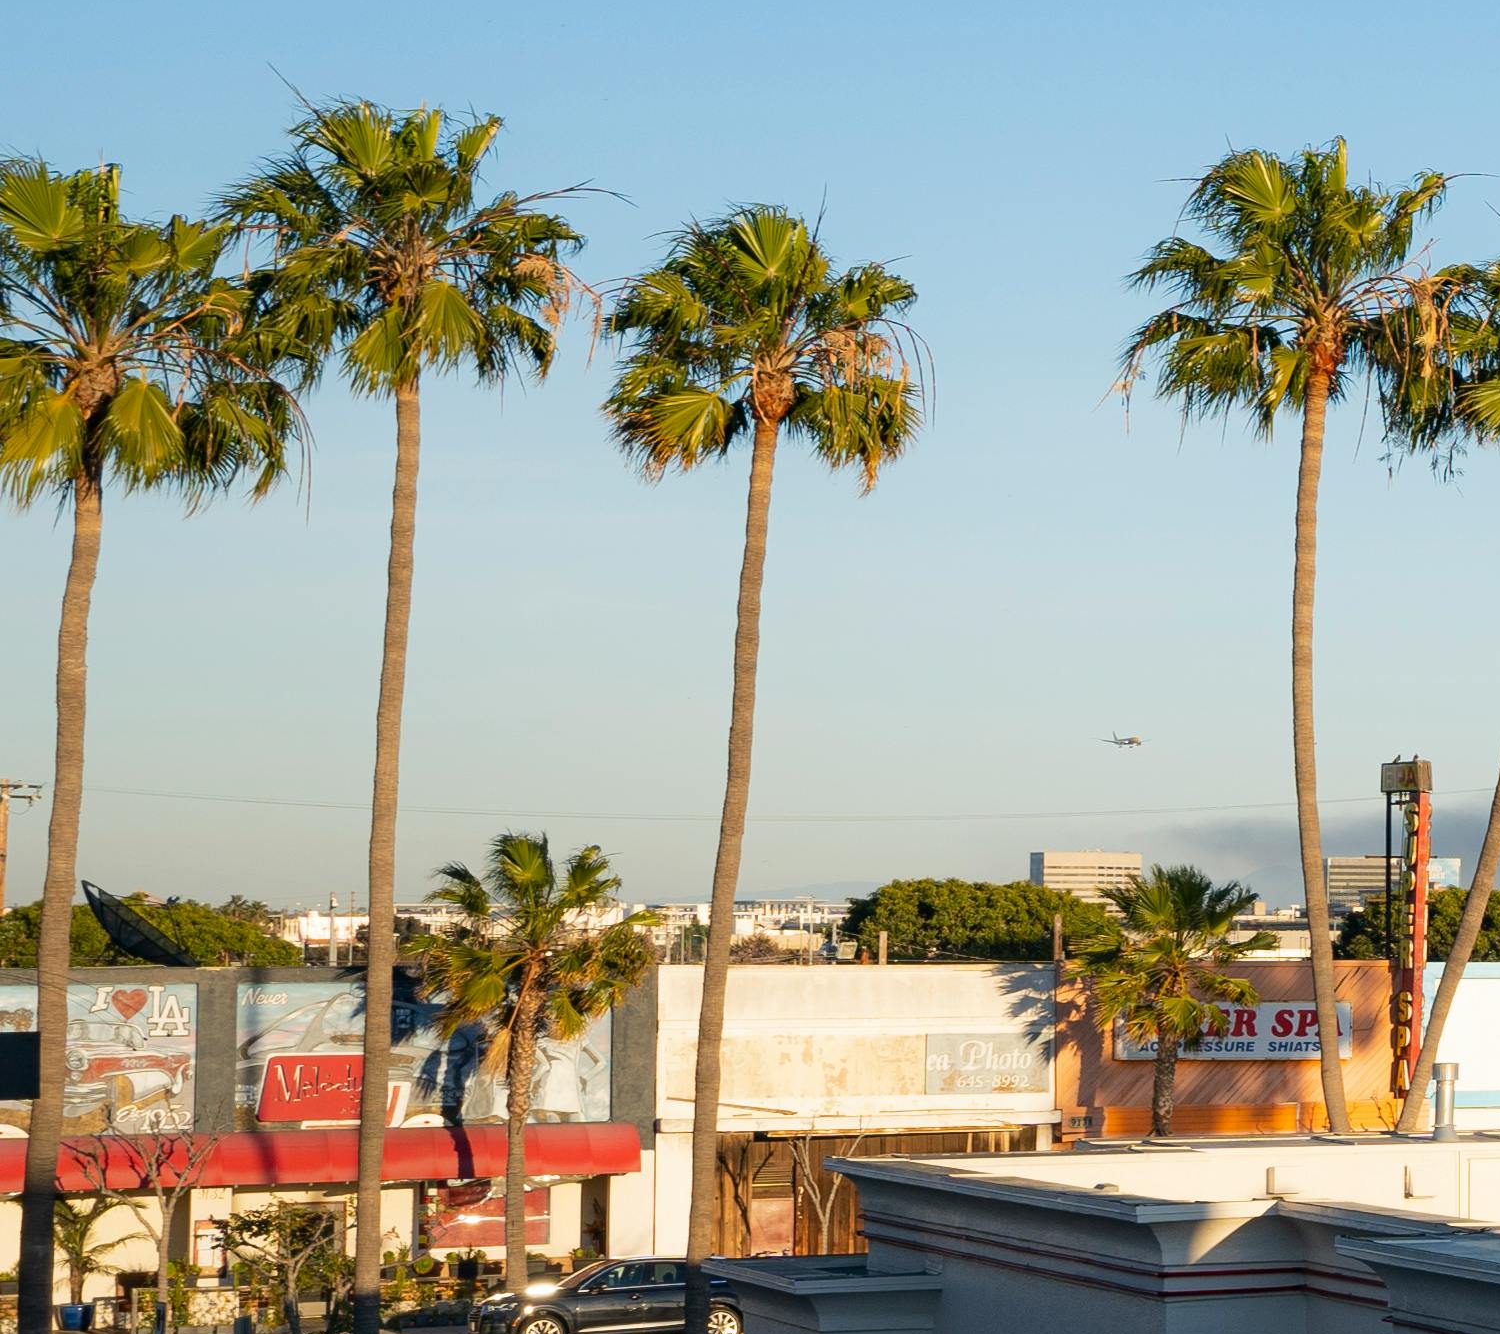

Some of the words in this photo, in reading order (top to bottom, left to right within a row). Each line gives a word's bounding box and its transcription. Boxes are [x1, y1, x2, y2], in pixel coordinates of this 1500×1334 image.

[241, 987, 288, 1006] Never
[1271, 1009, 1343, 1037] SP
[959, 1040, 1032, 1071] Photo
[957, 1074, 1030, 1088] 645-8992
